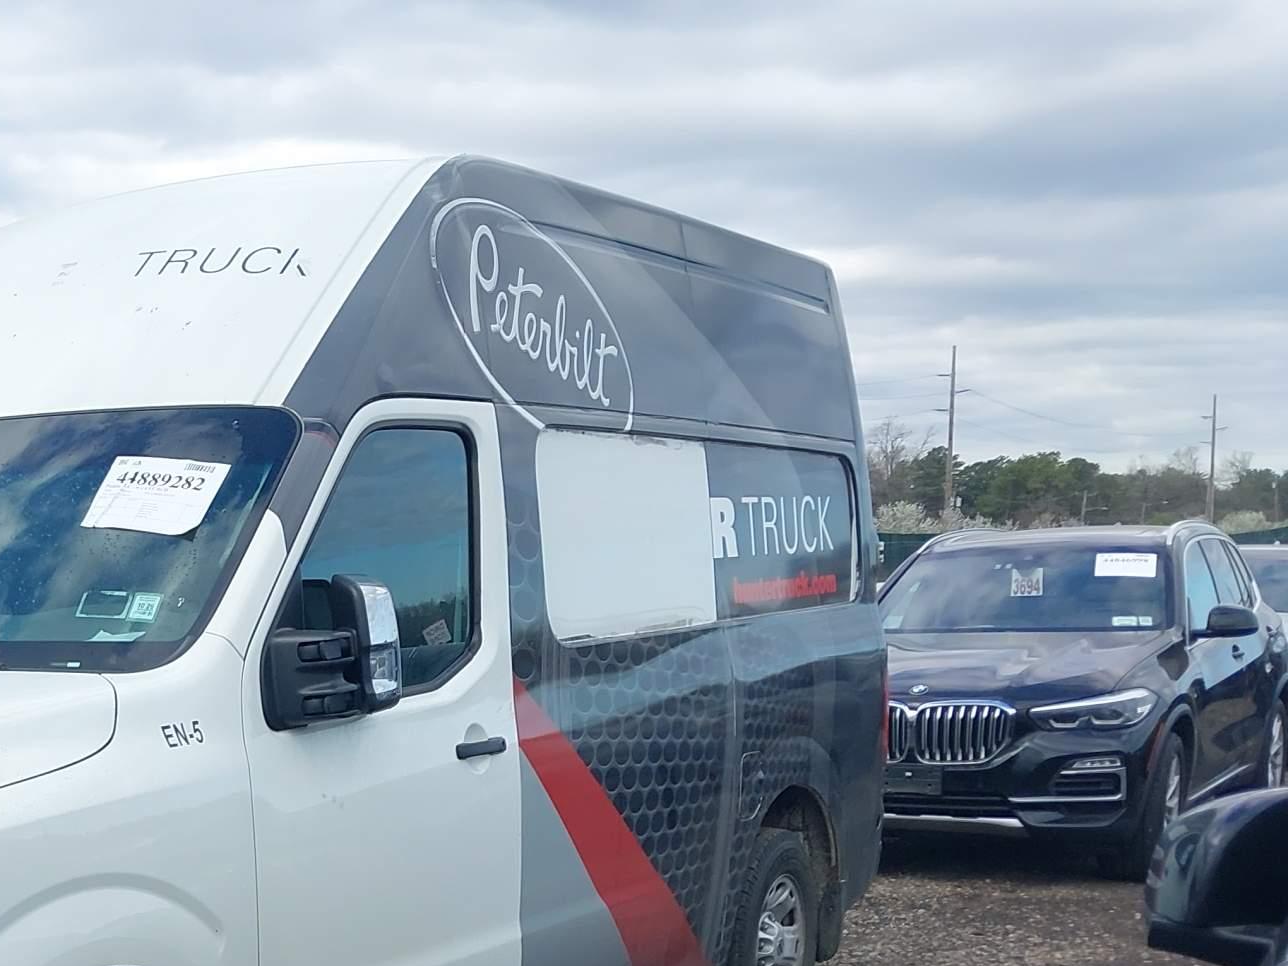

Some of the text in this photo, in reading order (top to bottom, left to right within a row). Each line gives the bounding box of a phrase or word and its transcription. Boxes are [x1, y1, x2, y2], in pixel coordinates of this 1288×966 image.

[134, 246, 306, 277] TRUCK
[469, 224, 618, 407] Peterbilt
[116, 471, 206, 491] 44889282
[741, 495, 834, 556] TRUCK
[161, 720, 203, 748] EN-5
